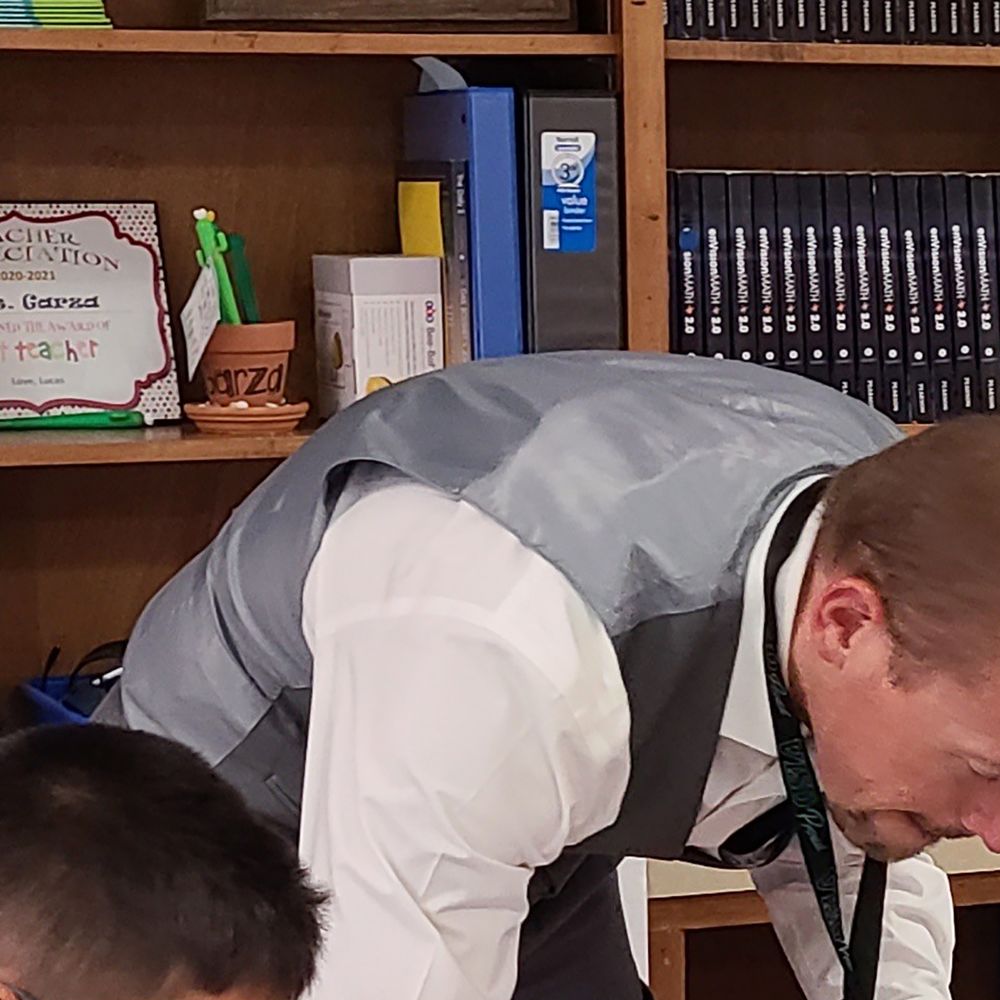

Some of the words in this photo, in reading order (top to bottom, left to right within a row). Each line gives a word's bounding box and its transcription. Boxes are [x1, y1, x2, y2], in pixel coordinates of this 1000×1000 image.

[0, 228, 81, 246] CHER
[0, 245, 119, 271] CIATION
[22, 293, 100, 310] Garza
[684, 317, 695, 334] 2.0
[711, 316, 722, 335] 2.0
[738, 316, 749, 334] 2.0
[762, 316, 773, 333] 2.0
[786, 315, 797, 332] 2.0
[810, 314, 820, 331] 2.0
[836, 314, 847, 331] 2.0
[860, 313, 871, 330] 2.0
[885, 315, 896, 331] 2.0
[910, 316, 920, 334] 2.0
[934, 314, 945, 331] 2.0
[957, 311, 967, 328] 2.0
[981, 313, 992, 330] 2.0
[14, 339, 99, 362] teacher
